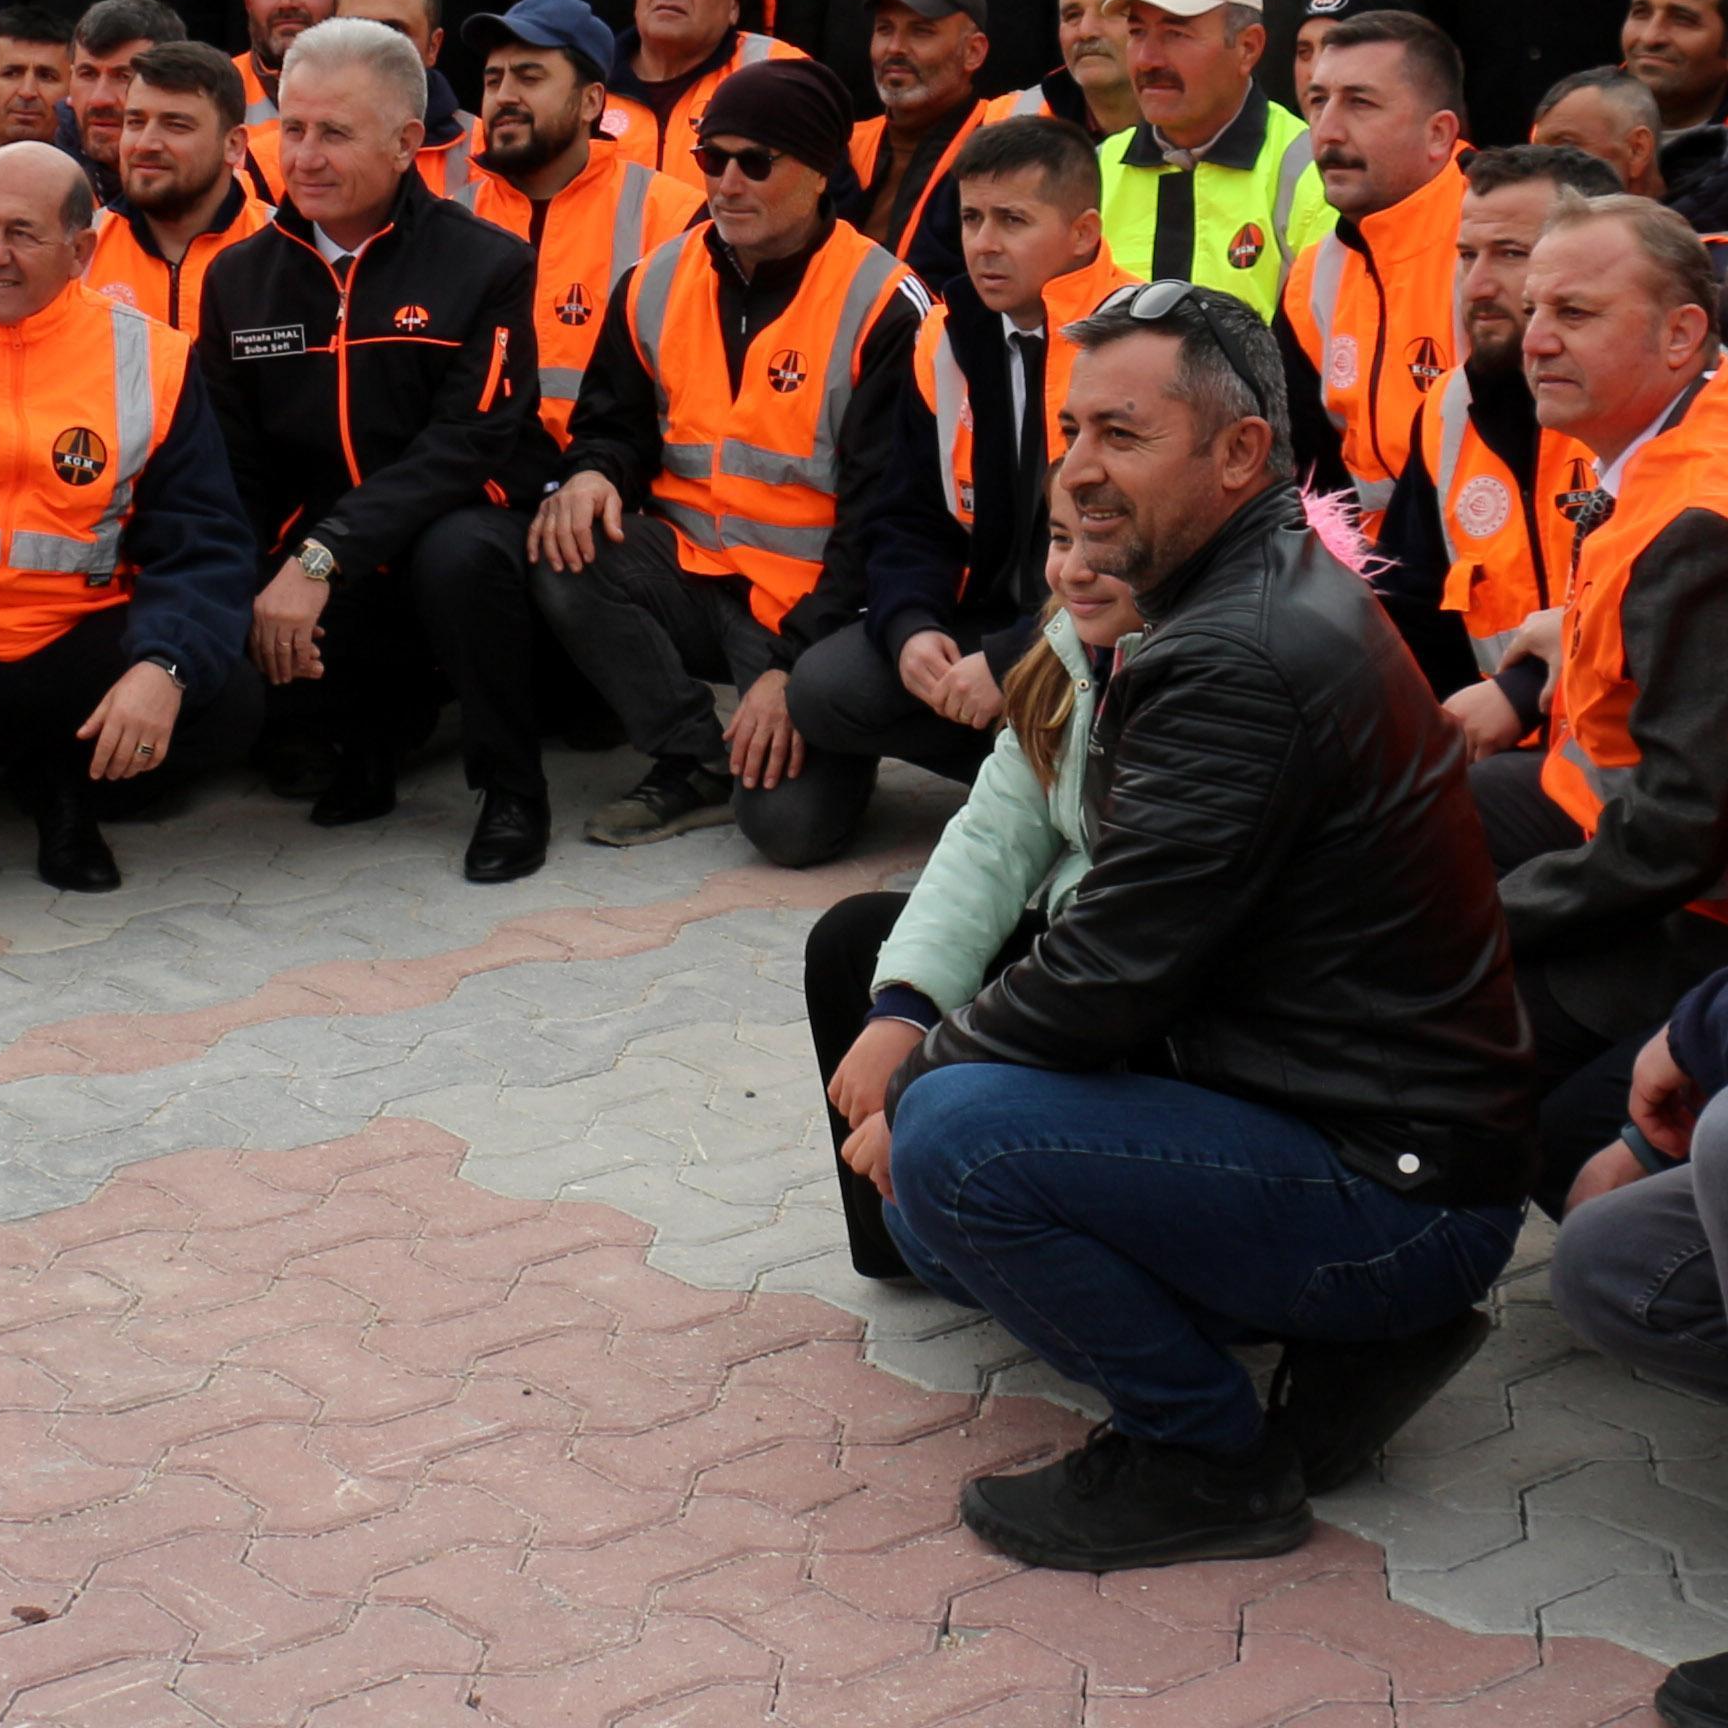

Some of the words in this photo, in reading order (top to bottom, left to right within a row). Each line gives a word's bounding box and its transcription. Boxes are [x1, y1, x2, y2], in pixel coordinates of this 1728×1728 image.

[235, 332, 271, 345] Mustafa
[273, 329, 300, 342] İMAL
[243, 343, 270, 356] Şube
[63, 454, 94, 470] KGM
